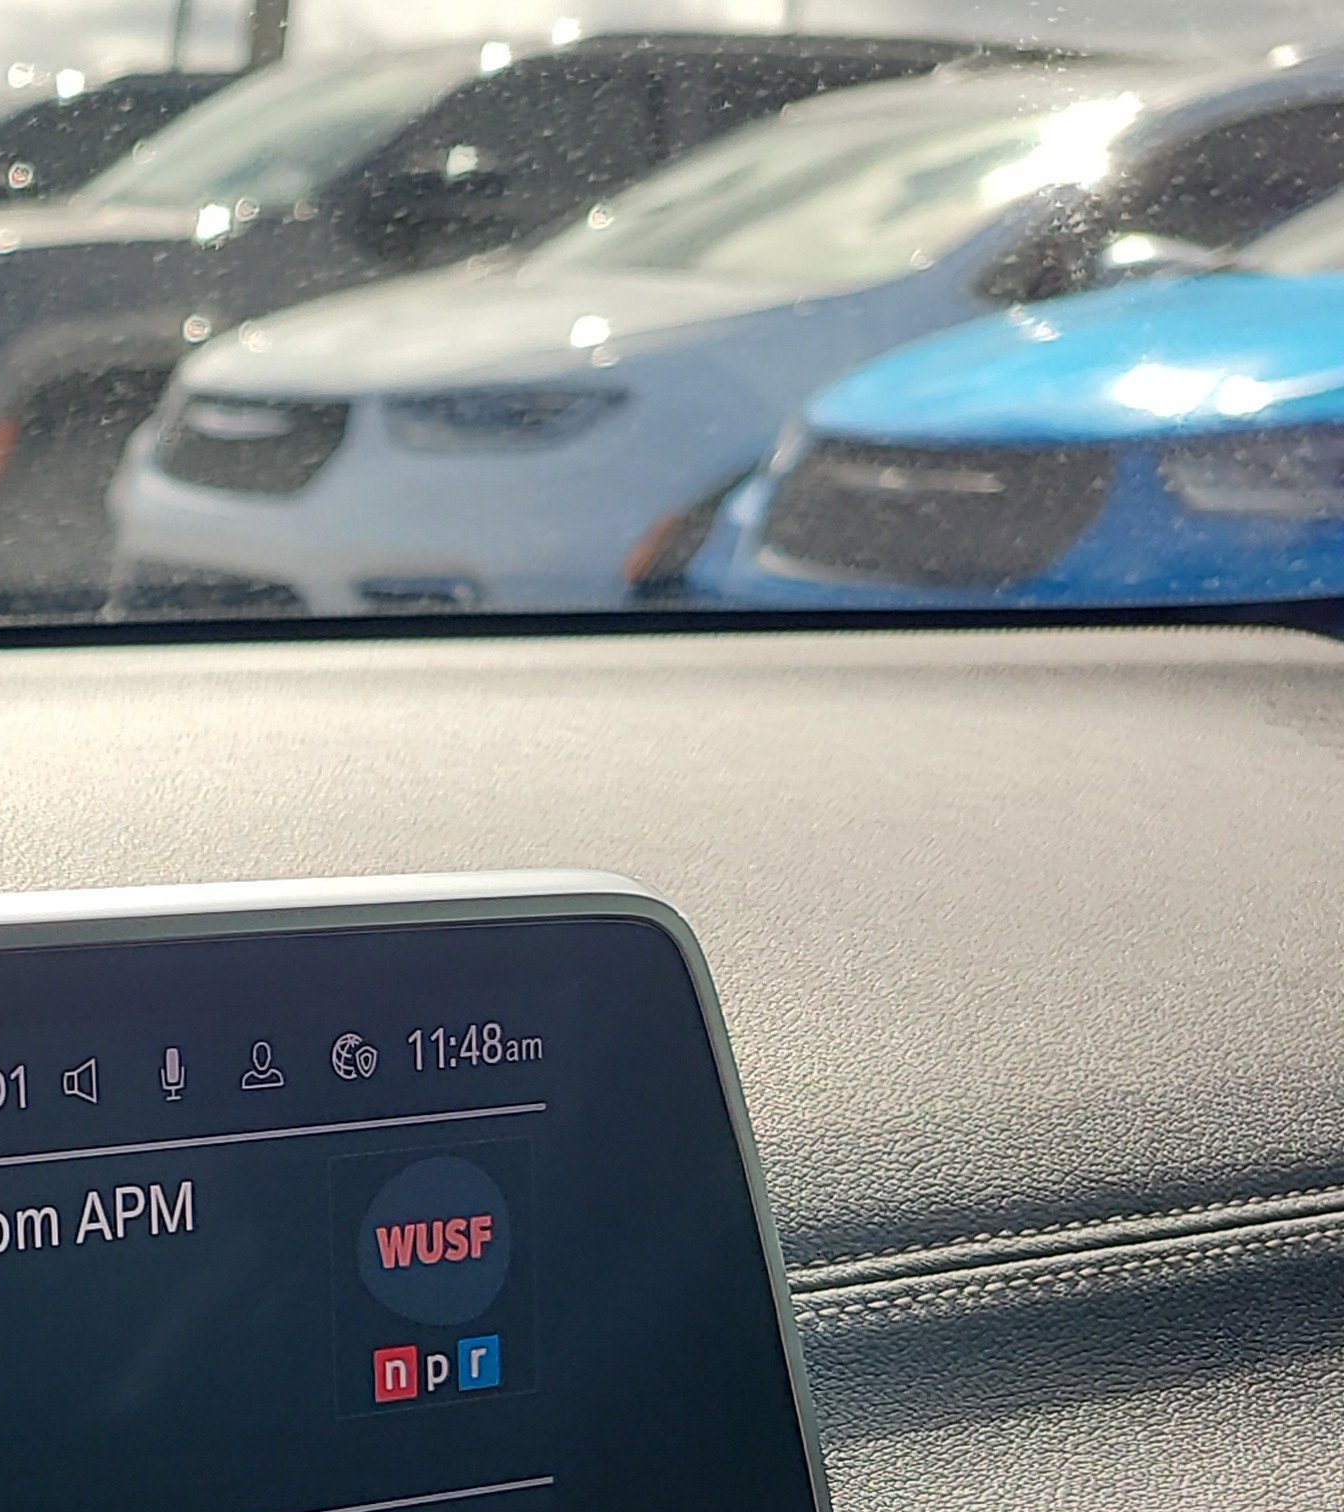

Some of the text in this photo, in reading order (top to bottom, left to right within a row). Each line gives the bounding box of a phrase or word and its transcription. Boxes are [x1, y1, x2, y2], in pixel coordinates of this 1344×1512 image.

[406, 1022, 545, 1072] 11:48am
[74, 1181, 196, 1246] APM
[375, 1215, 493, 1268] WUSF
[379, 1341, 494, 1398] npr
